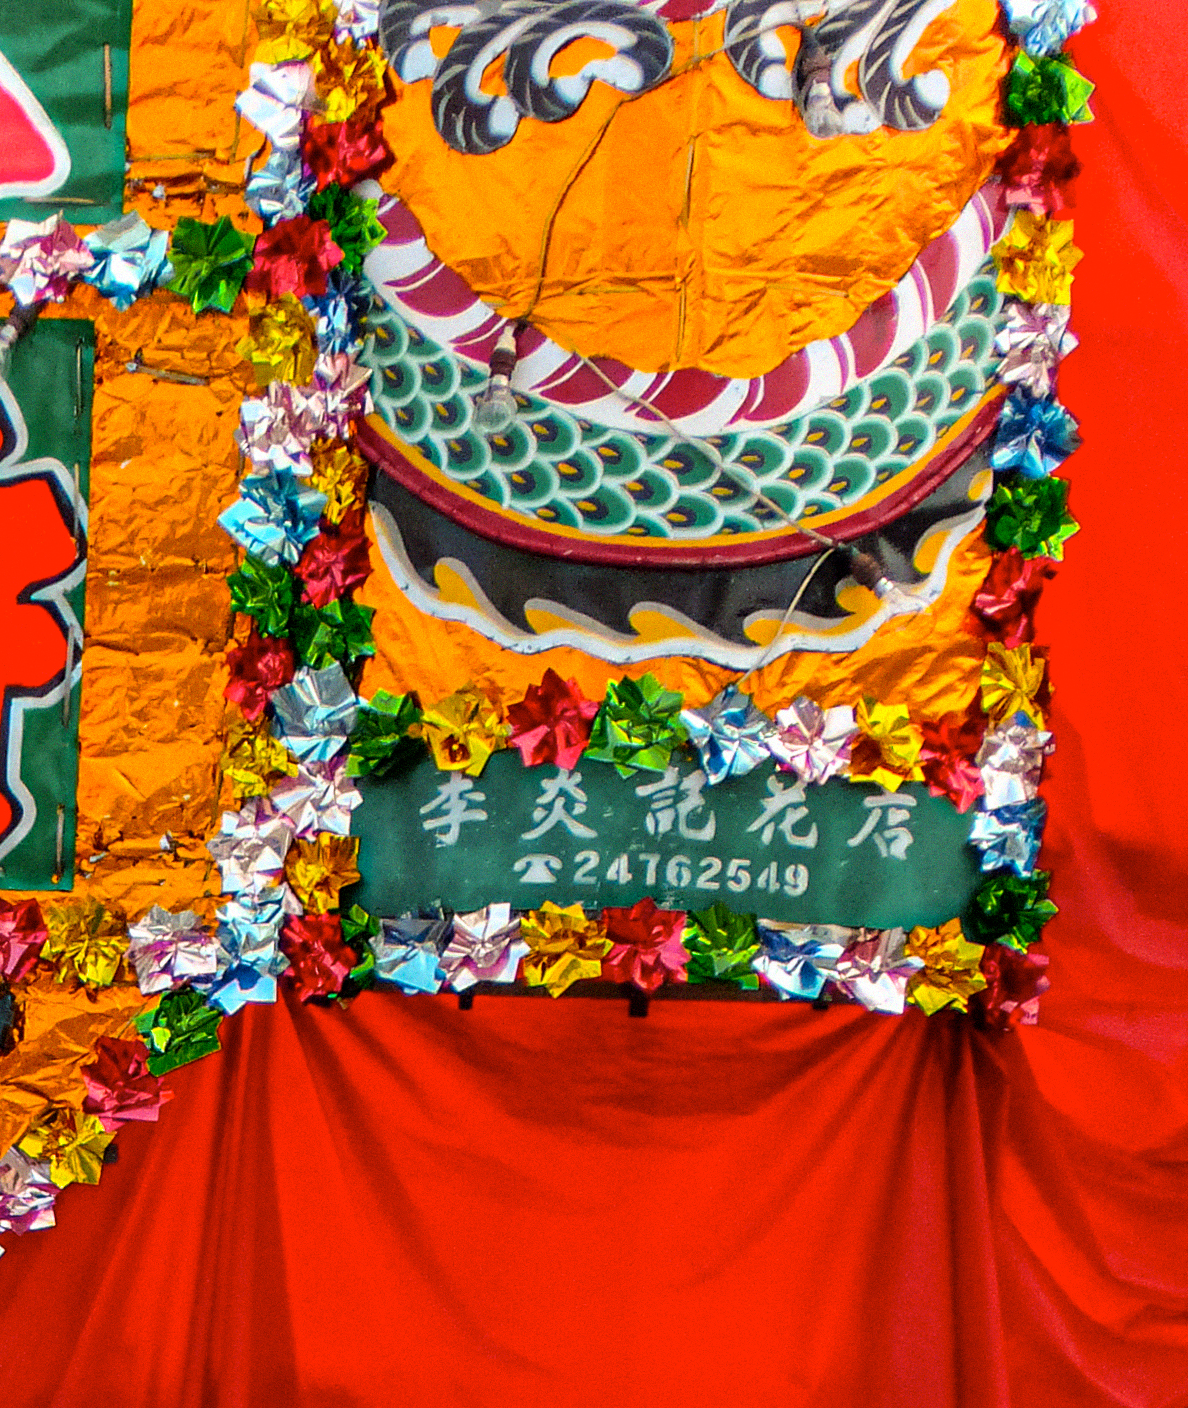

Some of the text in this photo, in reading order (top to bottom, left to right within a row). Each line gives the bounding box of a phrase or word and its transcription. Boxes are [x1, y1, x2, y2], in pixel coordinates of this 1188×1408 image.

[420, 765, 918, 862] 李炎記花店
[572, 849, 811, 897] 24762549
